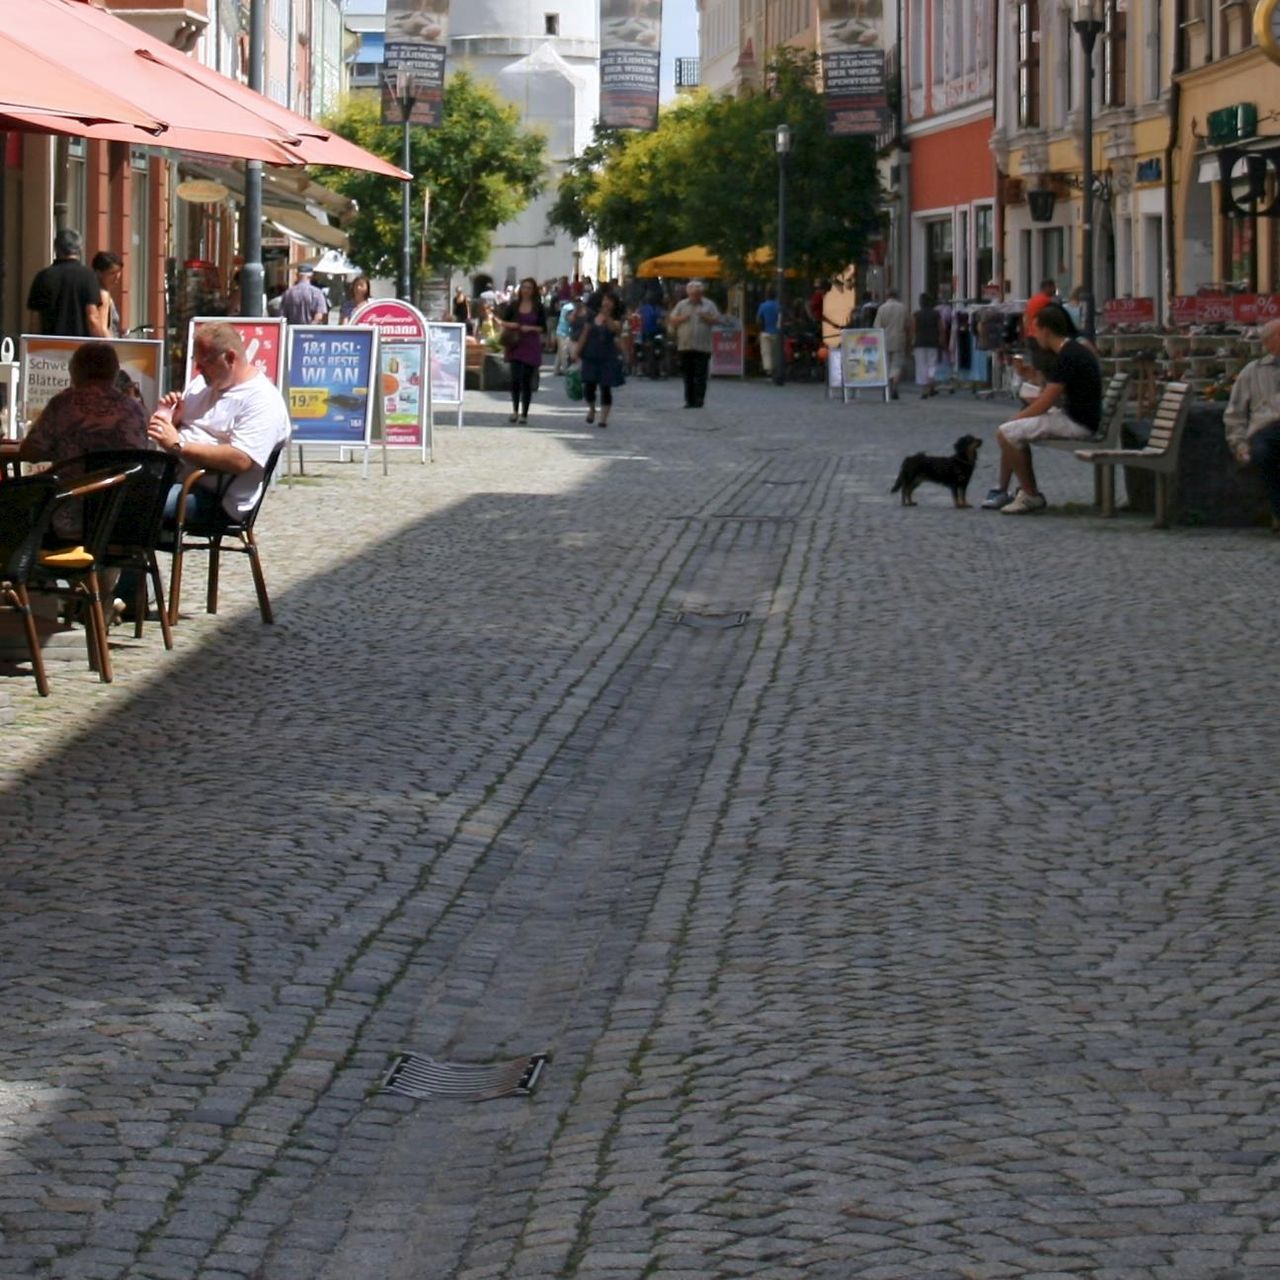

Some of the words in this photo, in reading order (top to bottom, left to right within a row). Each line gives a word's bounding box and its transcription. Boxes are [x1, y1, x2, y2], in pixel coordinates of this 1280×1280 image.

[302, 341, 326, 355] 1&1
[29, 359, 67, 371] Schwe
[302, 356, 325, 366] DAS
[328, 356, 359, 366] BESTE
[302, 367, 359, 384] WLAN
